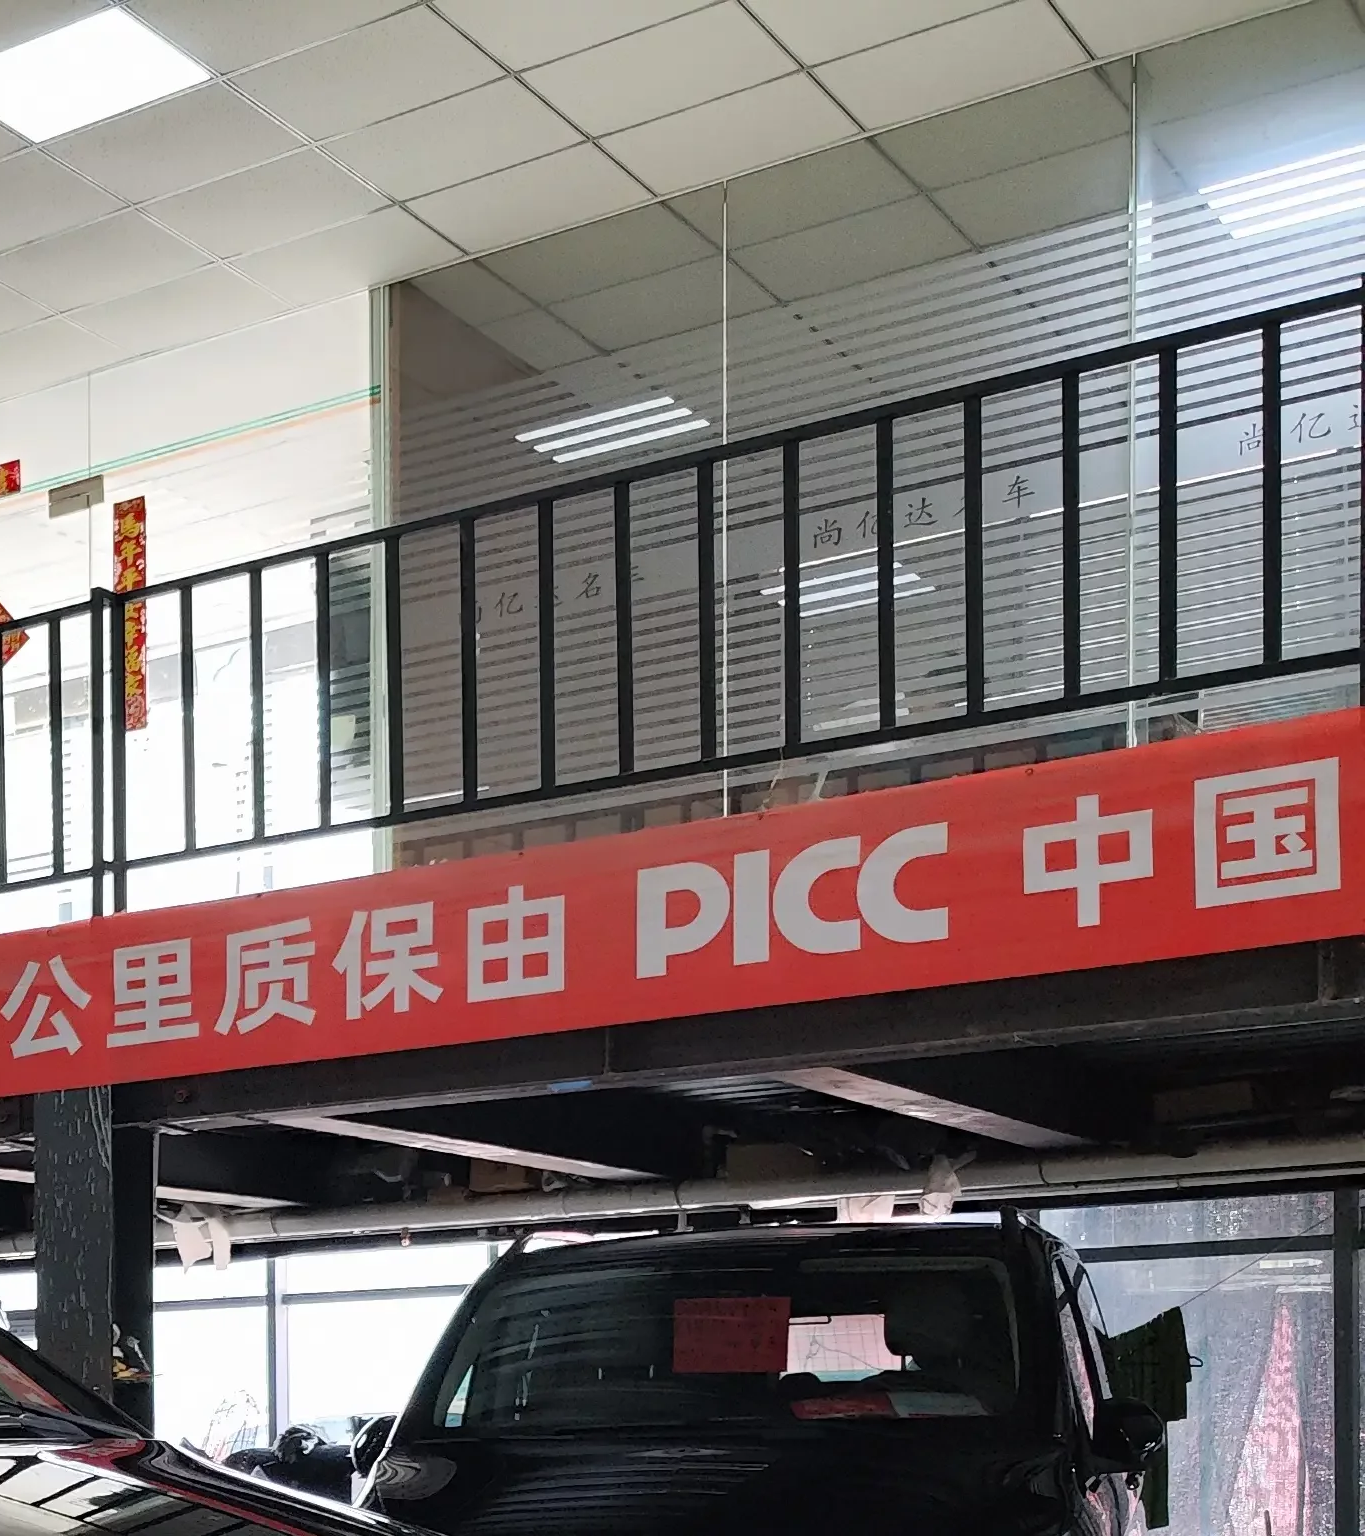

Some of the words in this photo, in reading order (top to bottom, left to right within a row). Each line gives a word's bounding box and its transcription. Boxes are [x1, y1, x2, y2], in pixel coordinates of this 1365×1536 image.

[813, 475, 1035, 548] 尚亿达车
[635, 822, 950, 980] PICC
[1023, 756, 1342, 928] 中国
